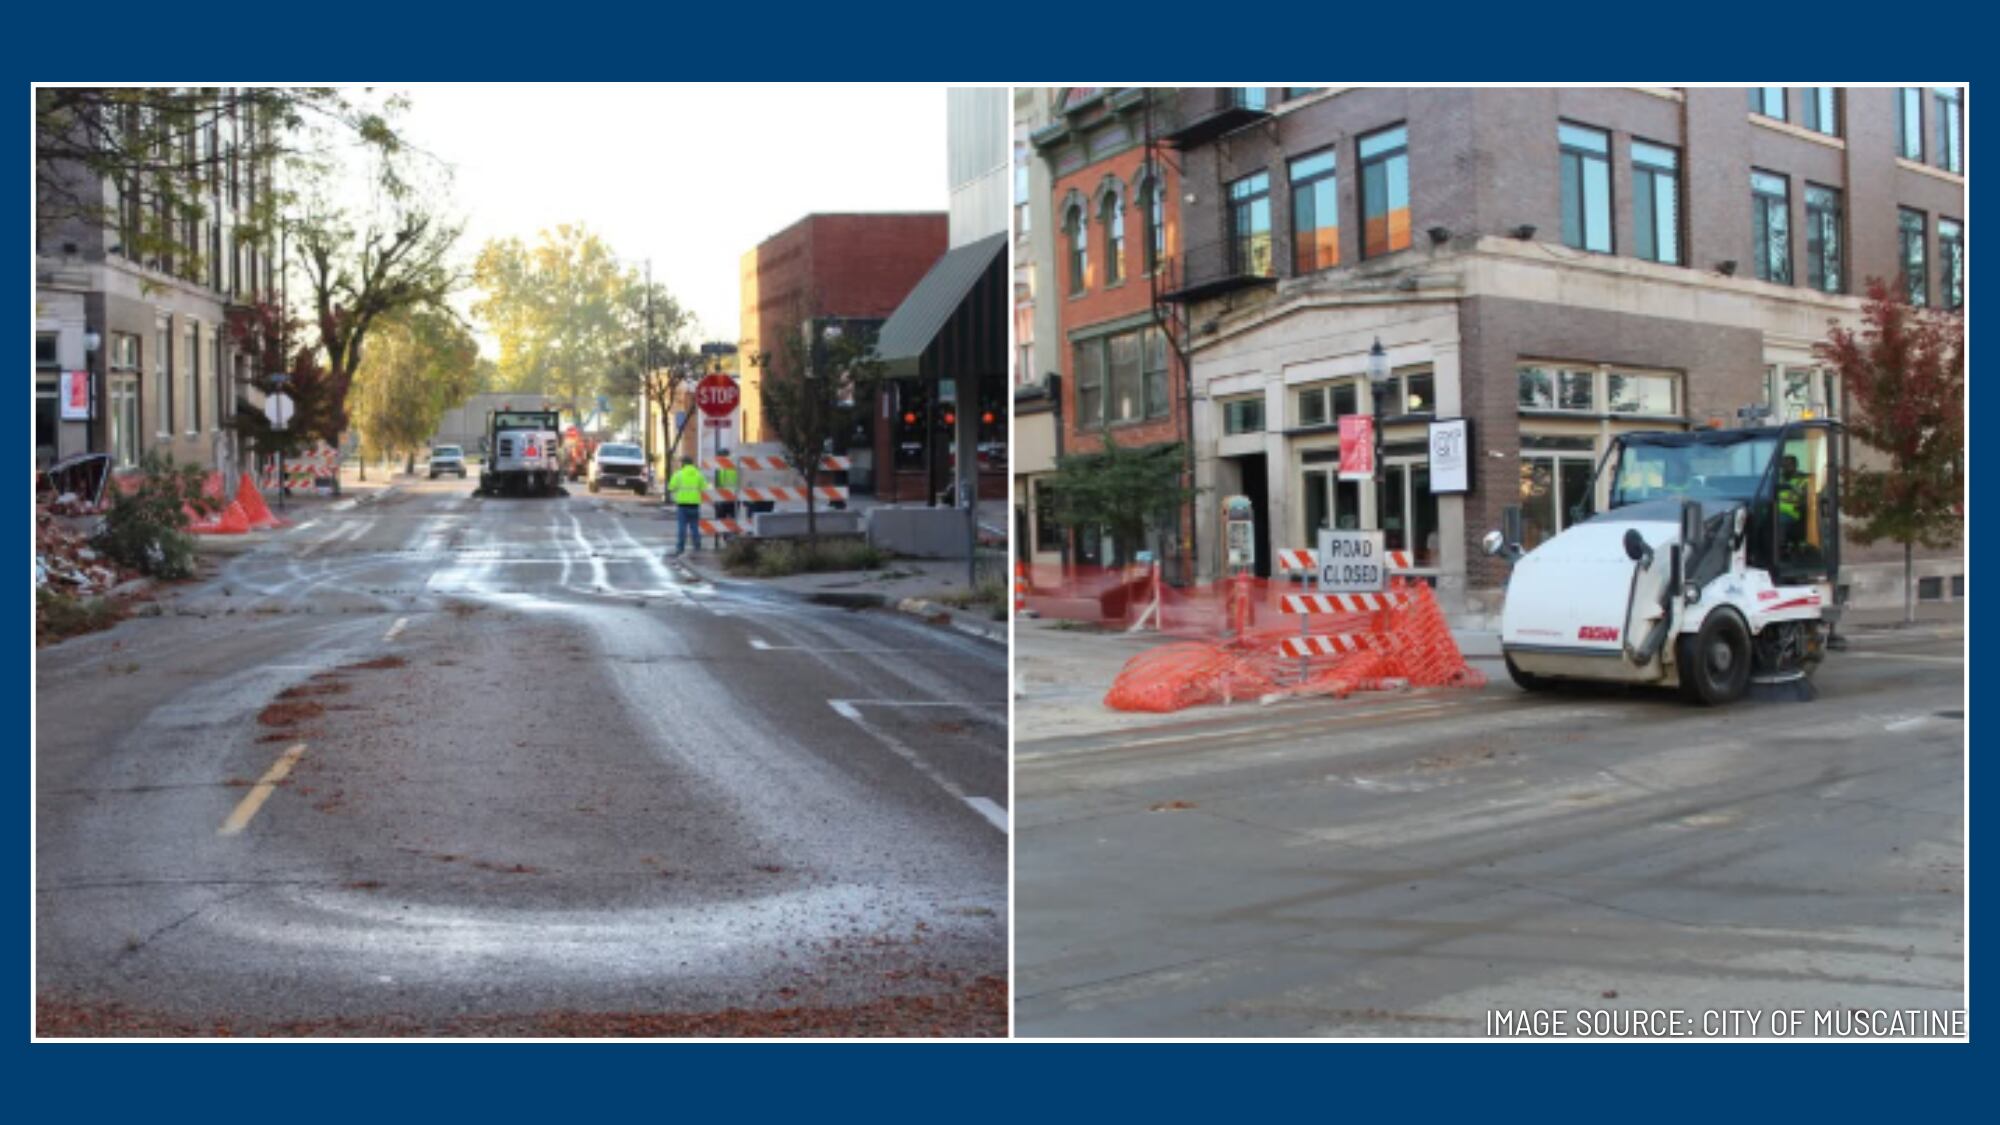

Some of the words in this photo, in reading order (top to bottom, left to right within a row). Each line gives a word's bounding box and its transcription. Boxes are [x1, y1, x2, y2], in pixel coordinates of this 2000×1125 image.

[701, 386, 738, 404] STOP
[1332, 540, 1372, 557] ROAD
[1324, 565, 1378, 584] CLOSED
